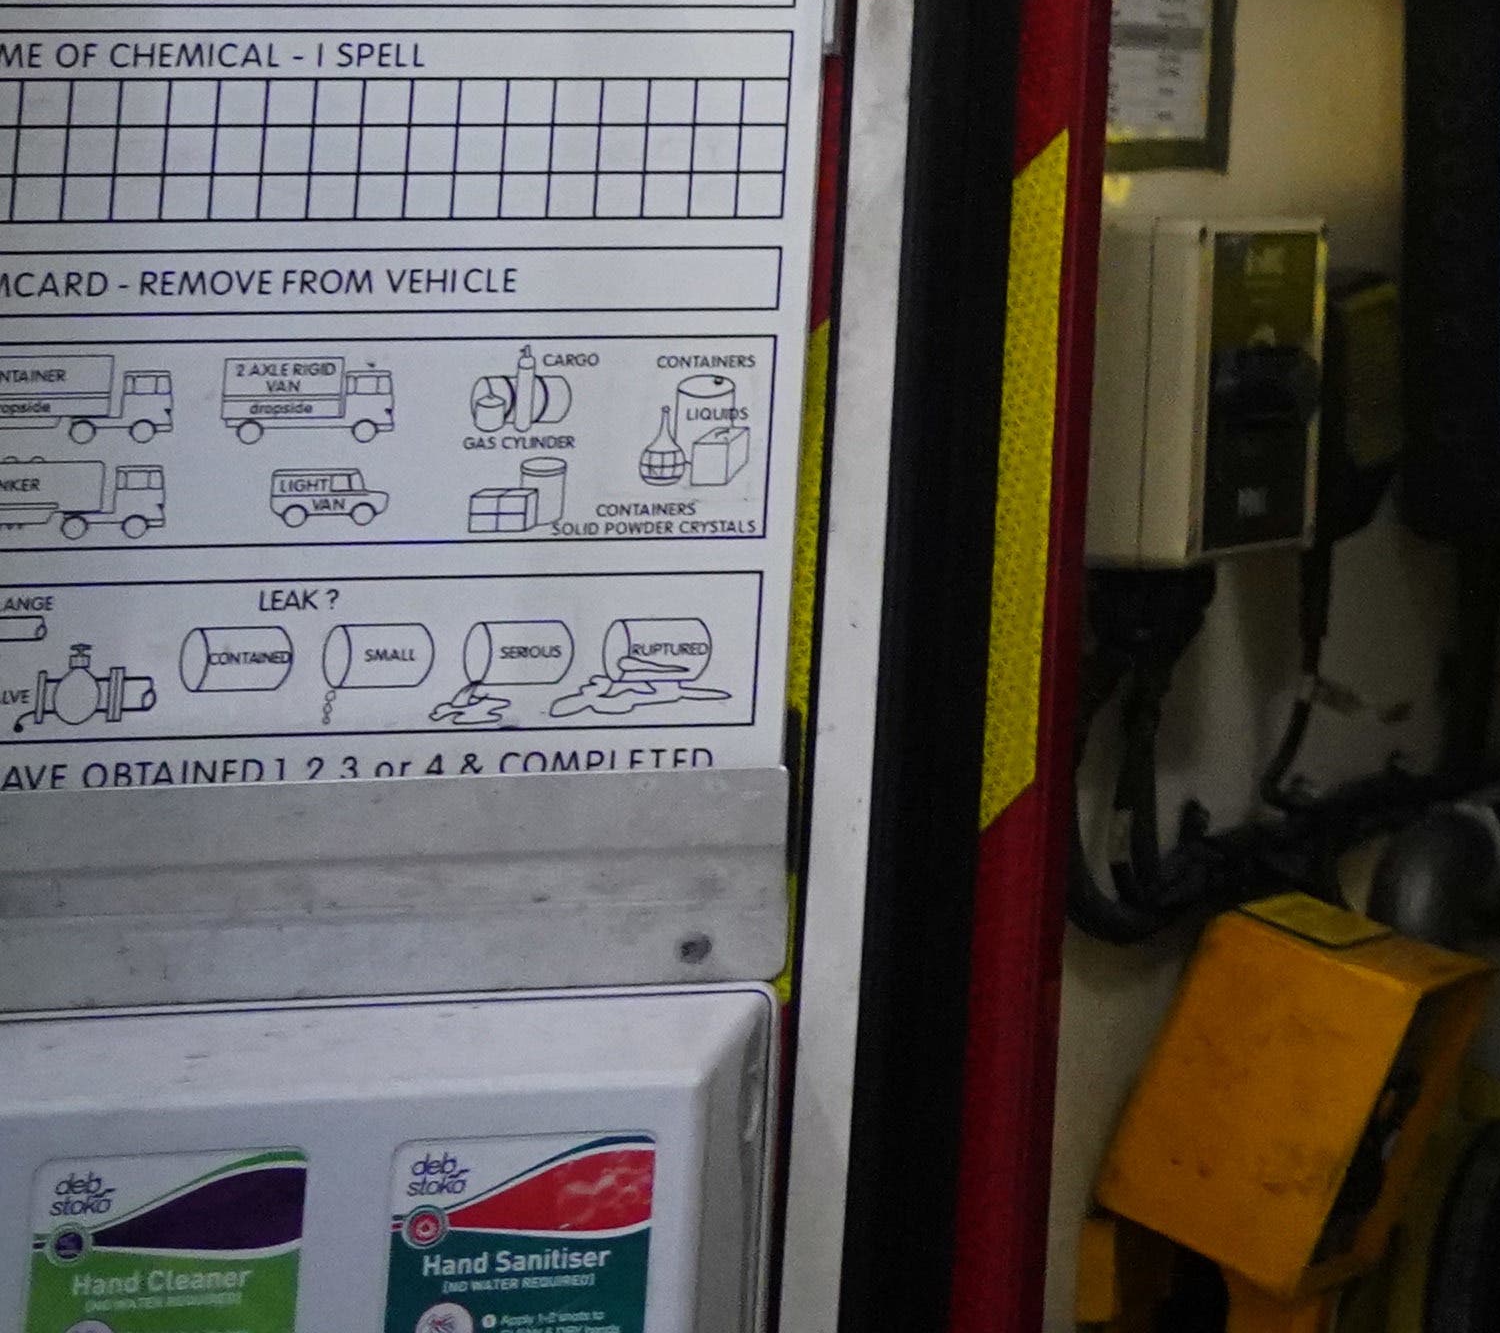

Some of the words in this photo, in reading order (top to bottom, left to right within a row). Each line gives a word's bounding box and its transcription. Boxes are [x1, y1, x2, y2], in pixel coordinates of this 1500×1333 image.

[56, 42, 98, 69] OF
[109, 42, 281, 69] CHEMICAL
[316, 42, 324, 69] I
[336, 42, 426, 69] SPELL
[138, 269, 274, 297] REMOVE
[282, 268, 374, 296] FROM
[386, 267, 520, 295] VEHICLE
[542, 353, 600, 368] CARGO
[656, 354, 757, 369] CONTAINERS
[235, 363, 245, 377] 2
[249, 363, 290, 377] AXLE
[292, 361, 337, 377] RIGID
[264, 379, 301, 393] VAN
[249, 400, 313, 416] dropside
[686, 407, 750, 422] LIQUIDS
[462, 436, 496, 450] GAS
[501, 435, 577, 450] CYLINDER
[279, 477, 329, 493] LIGHT
[312, 497, 347, 512] VAN
[596, 502, 697, 518] CONTAINERS
[552, 521, 600, 536] SOLID
[604, 520, 674, 536] POWDER
[679, 519, 757, 535] CRYSTALS
[0, 596, 55, 612] ANGE
[259, 589, 318, 612] LEAK
[326, 588, 340, 611] ?
[209, 650, 293, 666] CONTAINED
[364, 648, 417, 663] SMALL
[500, 644, 564, 660] SERIOUS
[631, 642, 710, 658] RUPTURED
[0, 689, 31, 705] LVE
[1, 763, 68, 791] AVE
[82, 759, 266, 789] OBTAINED
[276, 758, 286, 783] 1
[306, 757, 325, 781] 2
[341, 756, 359, 780] 3
[374, 761, 412, 779] or
[424, 755, 445, 776] 4
[460, 753, 484, 775] &
[412, 1152, 457, 1176] deb
[55, 1171, 102, 1195] deb
[407, 1176, 466, 1197] stoko
[49, 1195, 112, 1217] stoko
[422, 1254, 490, 1278] Hand
[494, 1248, 613, 1274] Sanitiser
[72, 1274, 141, 1297] Hand
[146, 1269, 254, 1293] Cleaner
[471, 1276, 519, 1292] WATER
